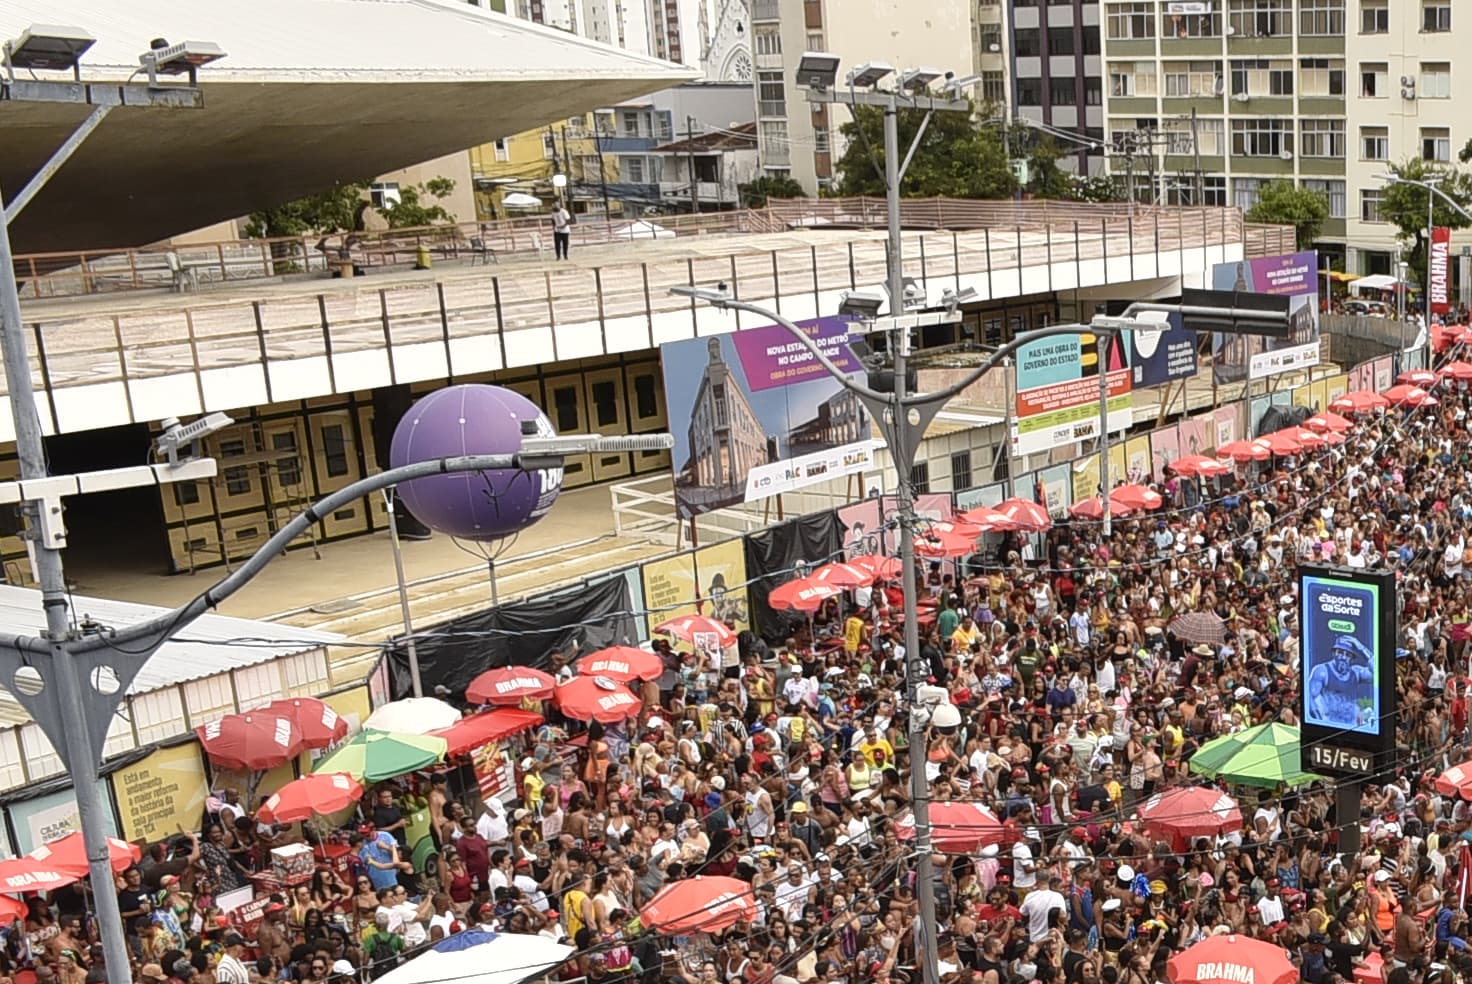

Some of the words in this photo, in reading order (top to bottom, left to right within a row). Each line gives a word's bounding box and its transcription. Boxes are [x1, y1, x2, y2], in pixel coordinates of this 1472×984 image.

[1432, 242, 1448, 304] BRAHMA
[767, 346, 786, 356] NOVA
[778, 356, 788, 366] NO
[790, 352, 814, 362] CAMPO
[1029, 348, 1041, 358] MAIS
[1042, 347, 1054, 356] UMA
[1055, 344, 1069, 354] OBRA
[1024, 359, 1048, 370] GOVERNO
[1050, 358, 1058, 366] DO
[1058, 354, 1078, 364] ESTADO
[591, 660, 630, 674] BRAHMA
[495, 677, 542, 694] BRAHMA
[598, 692, 635, 710] BRAHMA
[1314, 746, 1370, 772] 15/Fev
[124, 772, 138, 786] Está
[139, 770, 150, 780] em
[126, 777, 162, 796] andamento
[134, 792, 152, 804] maior
[154, 784, 178, 798] reforma
[130, 807, 139, 816] da
[140, 798, 164, 814] história
[165, 796, 174, 806] da
[132, 816, 146, 828] sala
[147, 806, 175, 822] principal
[135, 828, 144, 838] do
[144, 822, 156, 834] TCA
[4, 871, 62, 888] BRAHMA
[1196, 962, 1254, 984] BRAHMA
